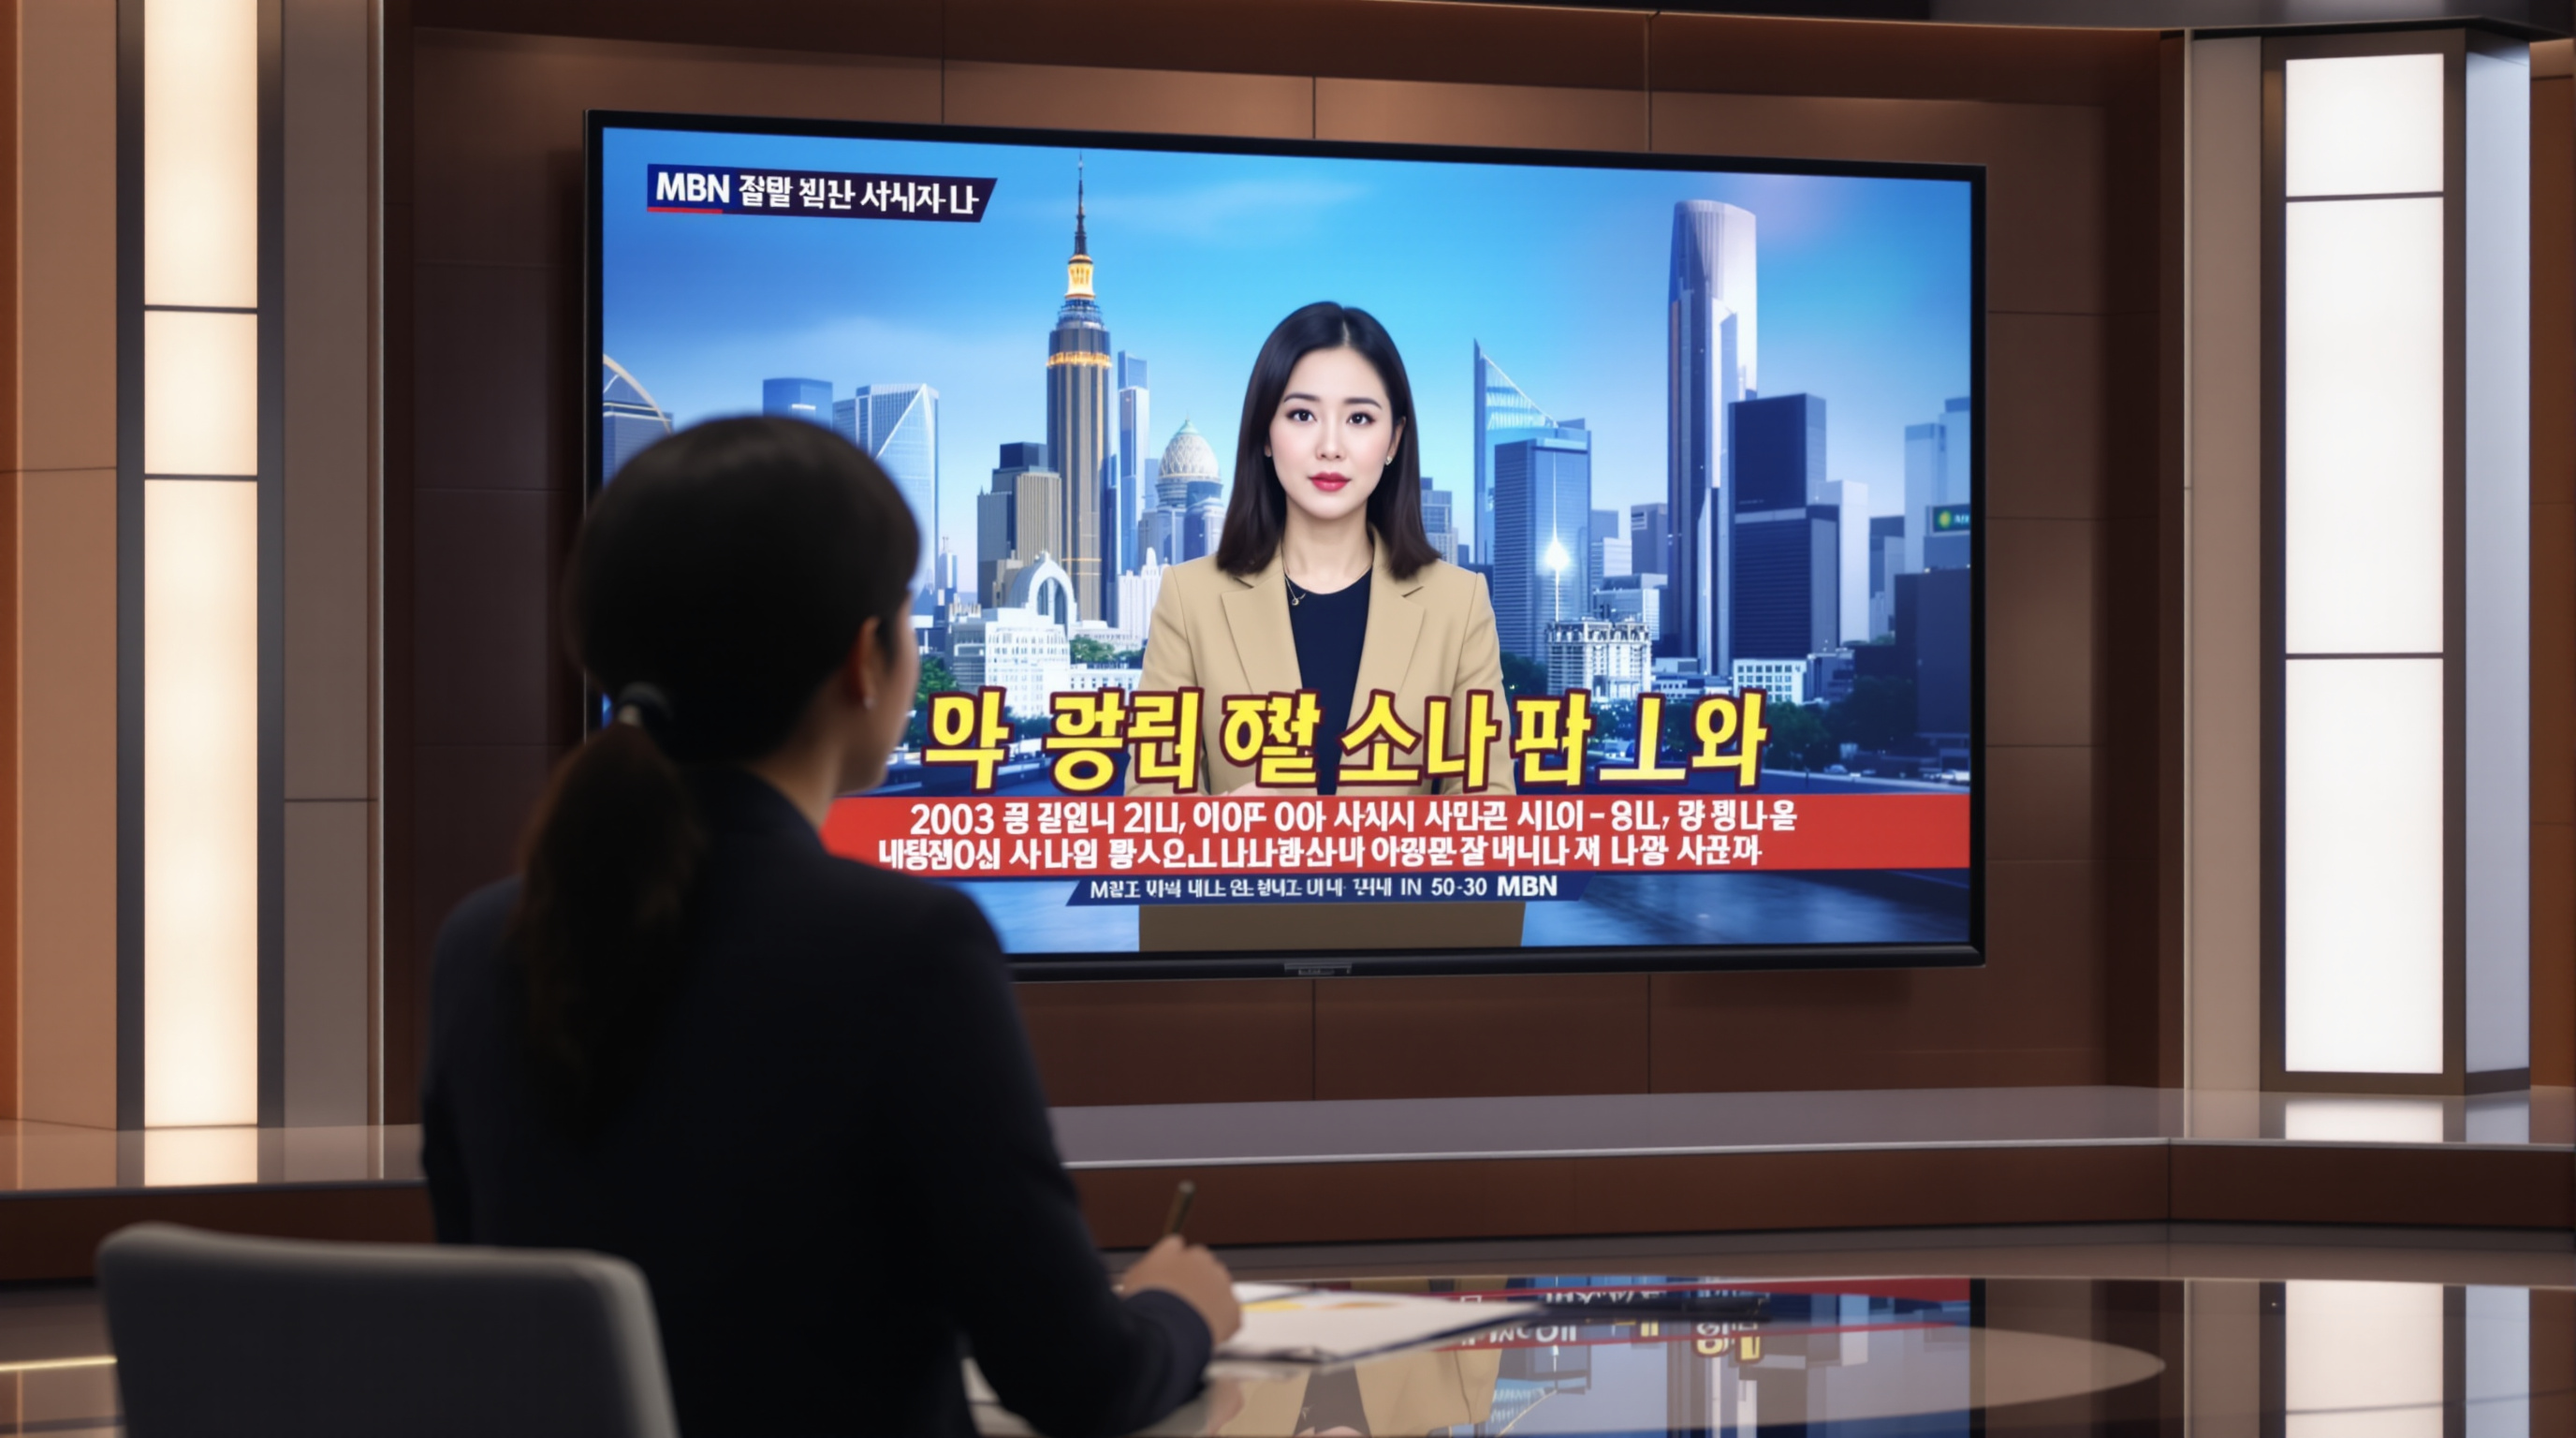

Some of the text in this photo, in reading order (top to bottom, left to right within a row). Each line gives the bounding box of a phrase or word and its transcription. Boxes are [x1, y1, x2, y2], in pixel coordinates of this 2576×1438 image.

[656, 171, 730, 203] MBN
[910, 802, 995, 836] 2003
[1431, 877, 1487, 896] 50-30
[1497, 874, 1558, 897] MBN
